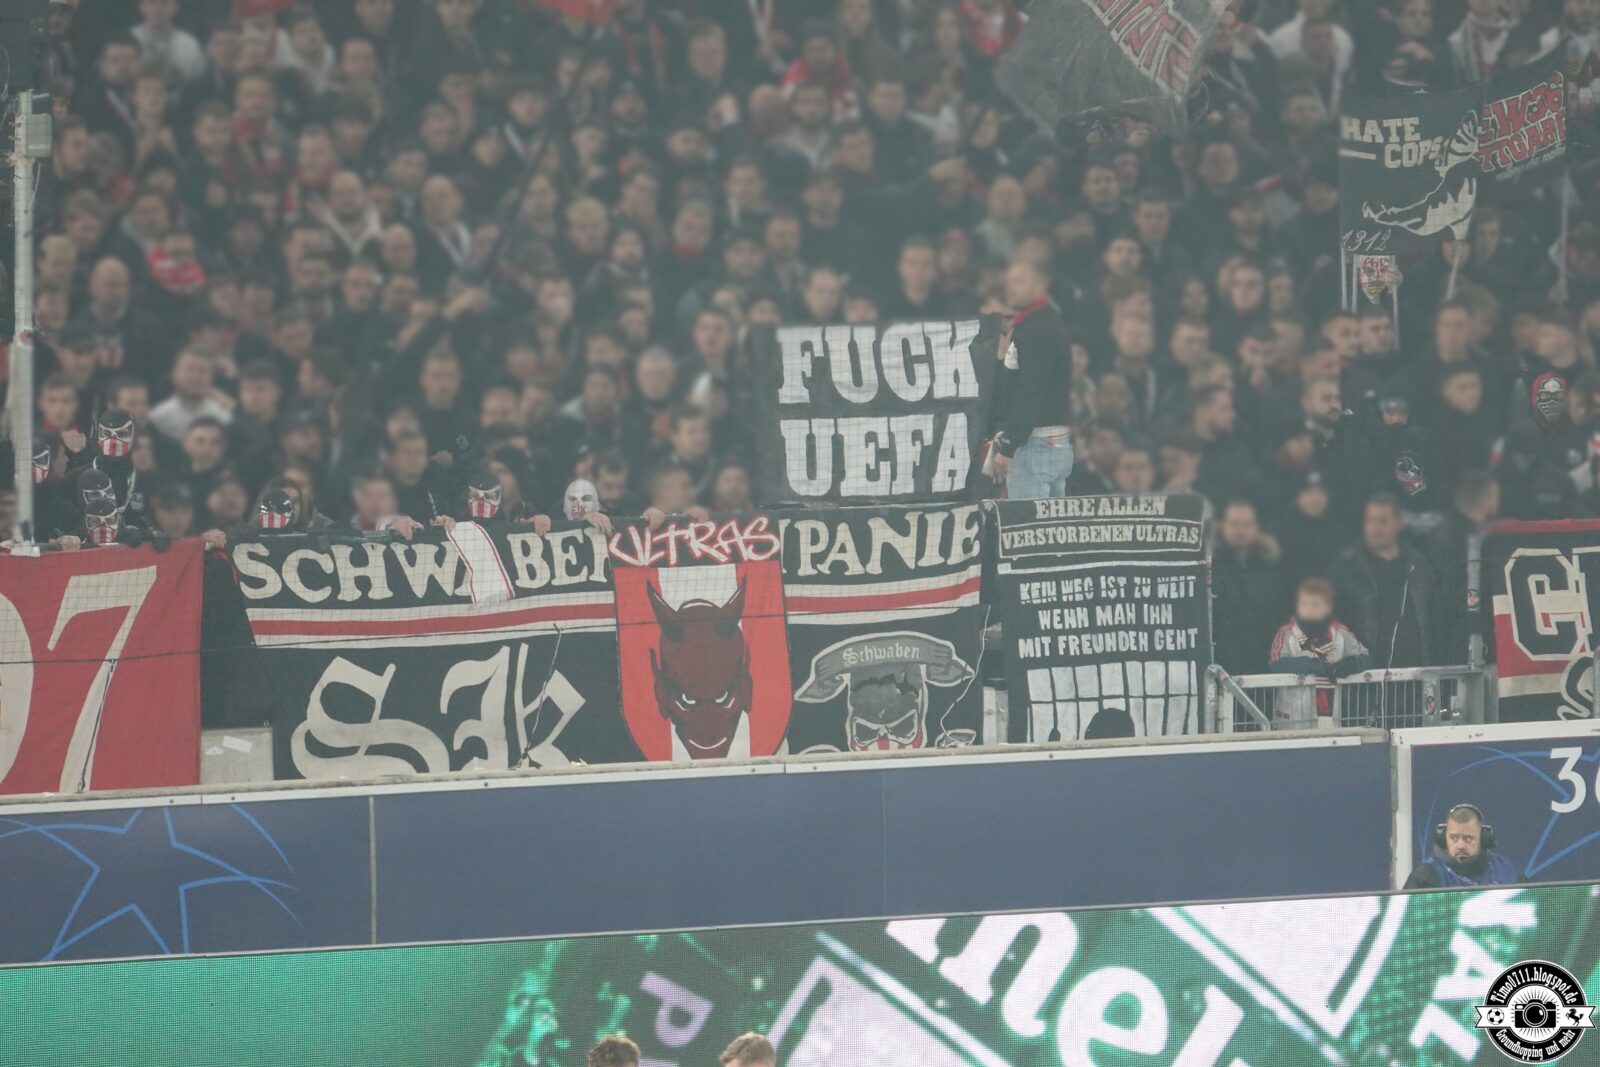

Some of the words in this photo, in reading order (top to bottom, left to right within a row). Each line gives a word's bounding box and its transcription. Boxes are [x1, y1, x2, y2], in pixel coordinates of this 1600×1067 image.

[1340, 116, 1421, 144] HATE
[1384, 136, 1444, 169] COPS
[1342, 229, 1391, 252] 1312
[777, 320, 981, 403] FUCK
[780, 413, 970, 497] UEFA
[1034, 498, 1096, 519] EHRE
[1098, 495, 1167, 517] ALLEN
[608, 515, 783, 567] ULTRAS
[1002, 525, 1133, 549] VERSTORBENEN
[1136, 523, 1199, 545] ULTRAS
[1019, 581, 1057, 604] KEIN
[1061, 577, 1094, 602] WEG
[1101, 575, 1127, 598] IST
[1134, 577, 1151, 598] ZU
[1157, 575, 1197, 598] WEIT
[1038, 607, 1089, 630] WENN
[1096, 603, 1136, 626] MAN
[1144, 603, 1173, 625] IHN
[842, 645, 920, 665] Schwaben
[1018, 636, 1051, 659] MIT
[1058, 631, 1149, 656] FREUNDEN
[1154, 628, 1198, 650] GEHT
